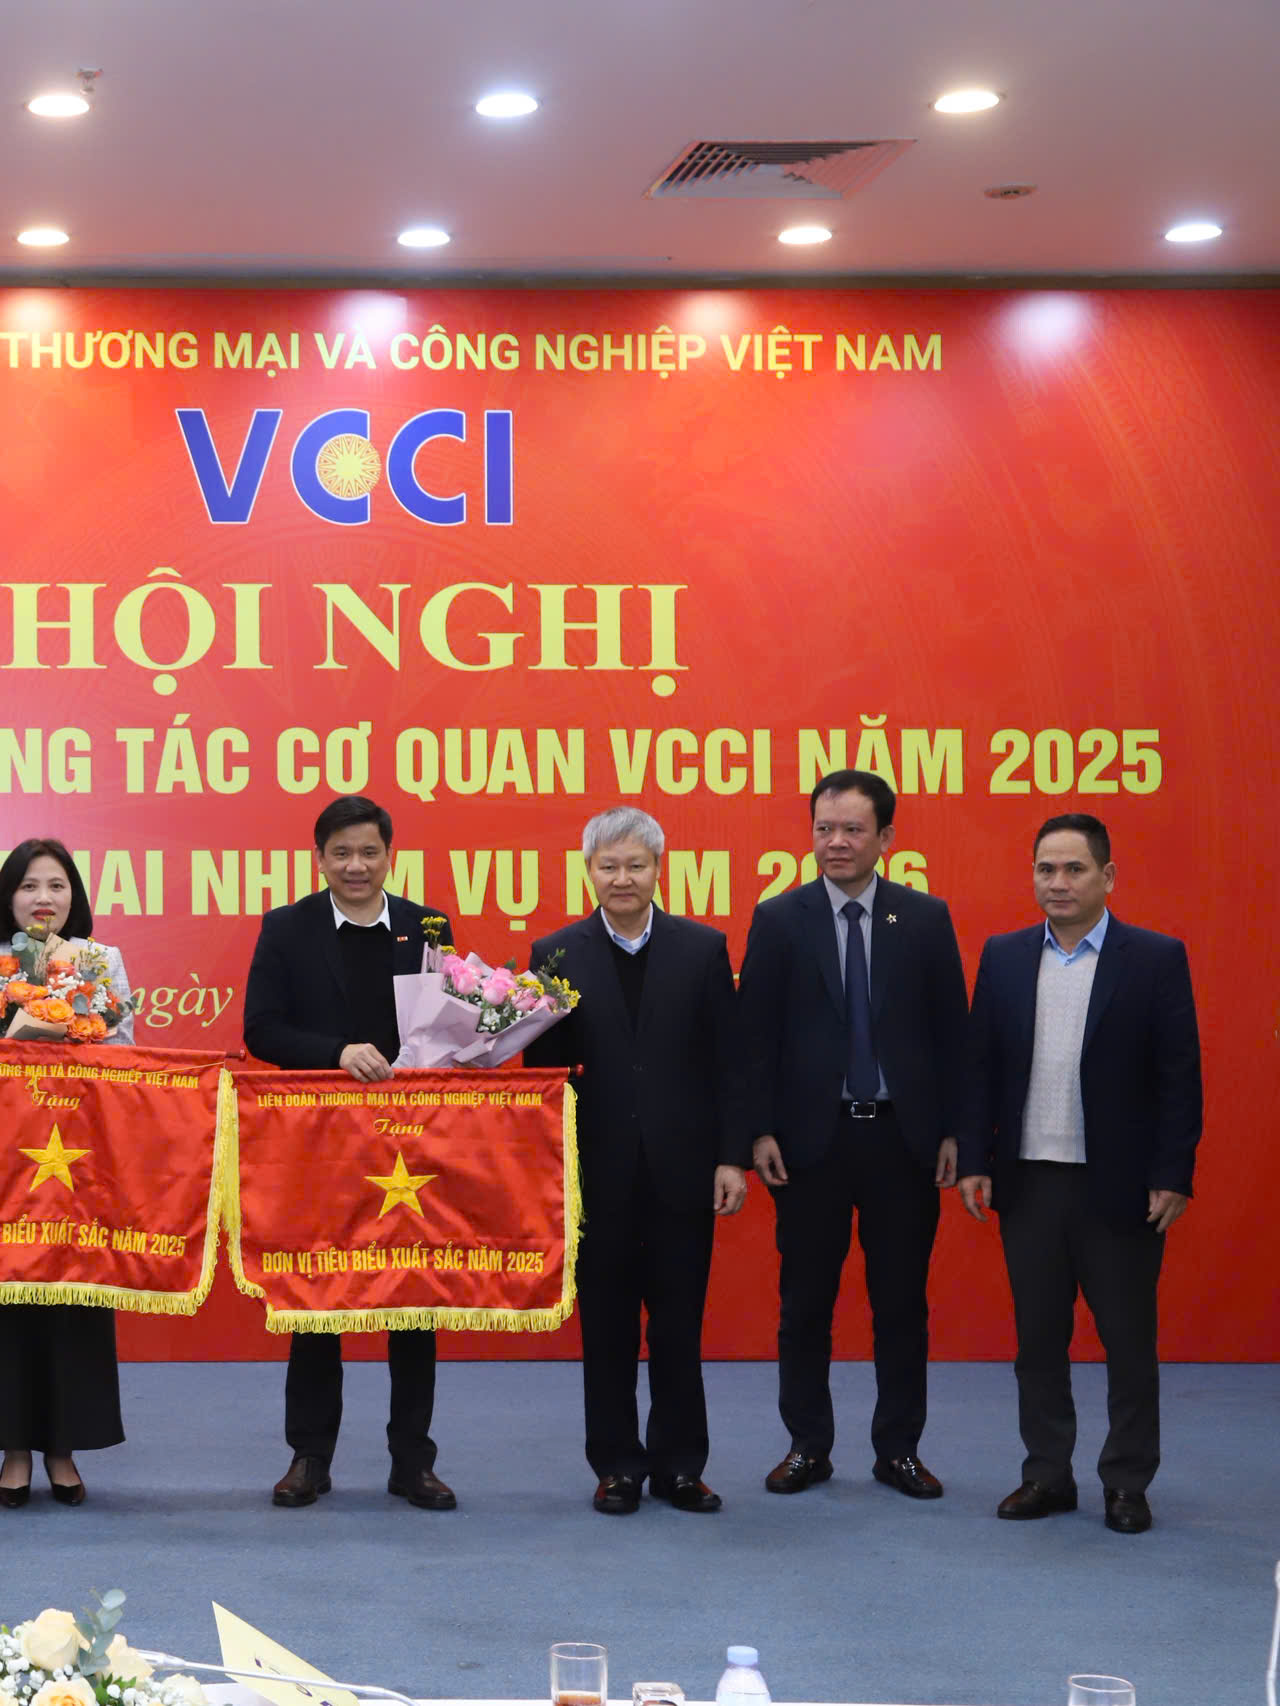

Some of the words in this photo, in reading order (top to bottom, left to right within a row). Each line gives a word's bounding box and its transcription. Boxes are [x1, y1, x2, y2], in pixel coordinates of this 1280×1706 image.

[0, 327, 199, 370] THƯƠNG
[214, 332, 301, 378] MẠI
[314, 322, 376, 371] VÀ
[389, 324, 521, 371] CÔNG
[535, 324, 708, 379] NGHIỆP
[719, 324, 823, 379] VIỆT
[836, 333, 942, 371] NAM
[174, 407, 514, 526] VCCI
[0, 566, 274, 696] HỘI
[312, 581, 689, 697] NGHỊ
[115, 712, 250, 795] TÁC
[275, 720, 373, 795] CƠ
[395, 728, 586, 803] QUAN
[609, 728, 772, 795] VCCI
[798, 713, 964, 795] NĂM
[989, 728, 1163, 795] 2025
[191, 850, 424, 916] NHIM
[449, 850, 540, 931] VỤ
[566, 850, 730, 916] NM
[50, 1062, 65, 1078] VÀ
[67, 1063, 99, 1079] CÔNG
[101, 1067, 143, 1086] NGHIỆP
[145, 1071, 170, 1088] VIỆT
[171, 1074, 199, 1089] NAM
[257, 1092, 282, 1107] LIÊN
[320, 1091, 364, 1106] THƯƠNG
[367, 1092, 389, 1108] MẠI
[391, 1090, 407, 1106] VÀ
[409, 1090, 441, 1106] CÔNG
[443, 1090, 486, 1108] NGHIỆP
[488, 1090, 513, 1108] VIỆT
[515, 1092, 543, 1106] NAM
[373, 1118, 425, 1137] Tặng
[2, 1213, 37, 1245] BIỂU
[40, 1216, 76, 1245] XUẤT
[78, 1217, 109, 1249] SẮC
[112, 1225, 147, 1254] NĂM
[149, 1233, 188, 1257] 2025
[262, 1251, 293, 1273] ĐƠN
[297, 1252, 313, 1279] VỊ
[316, 1247, 348, 1273] TIÊU
[352, 1241, 386, 1272] BIỂU
[391, 1240, 429, 1270] XUẤT
[434, 1240, 464, 1270] SẮC
[467, 1244, 503, 1272] NĂM
[507, 1251, 545, 1273] 2025
